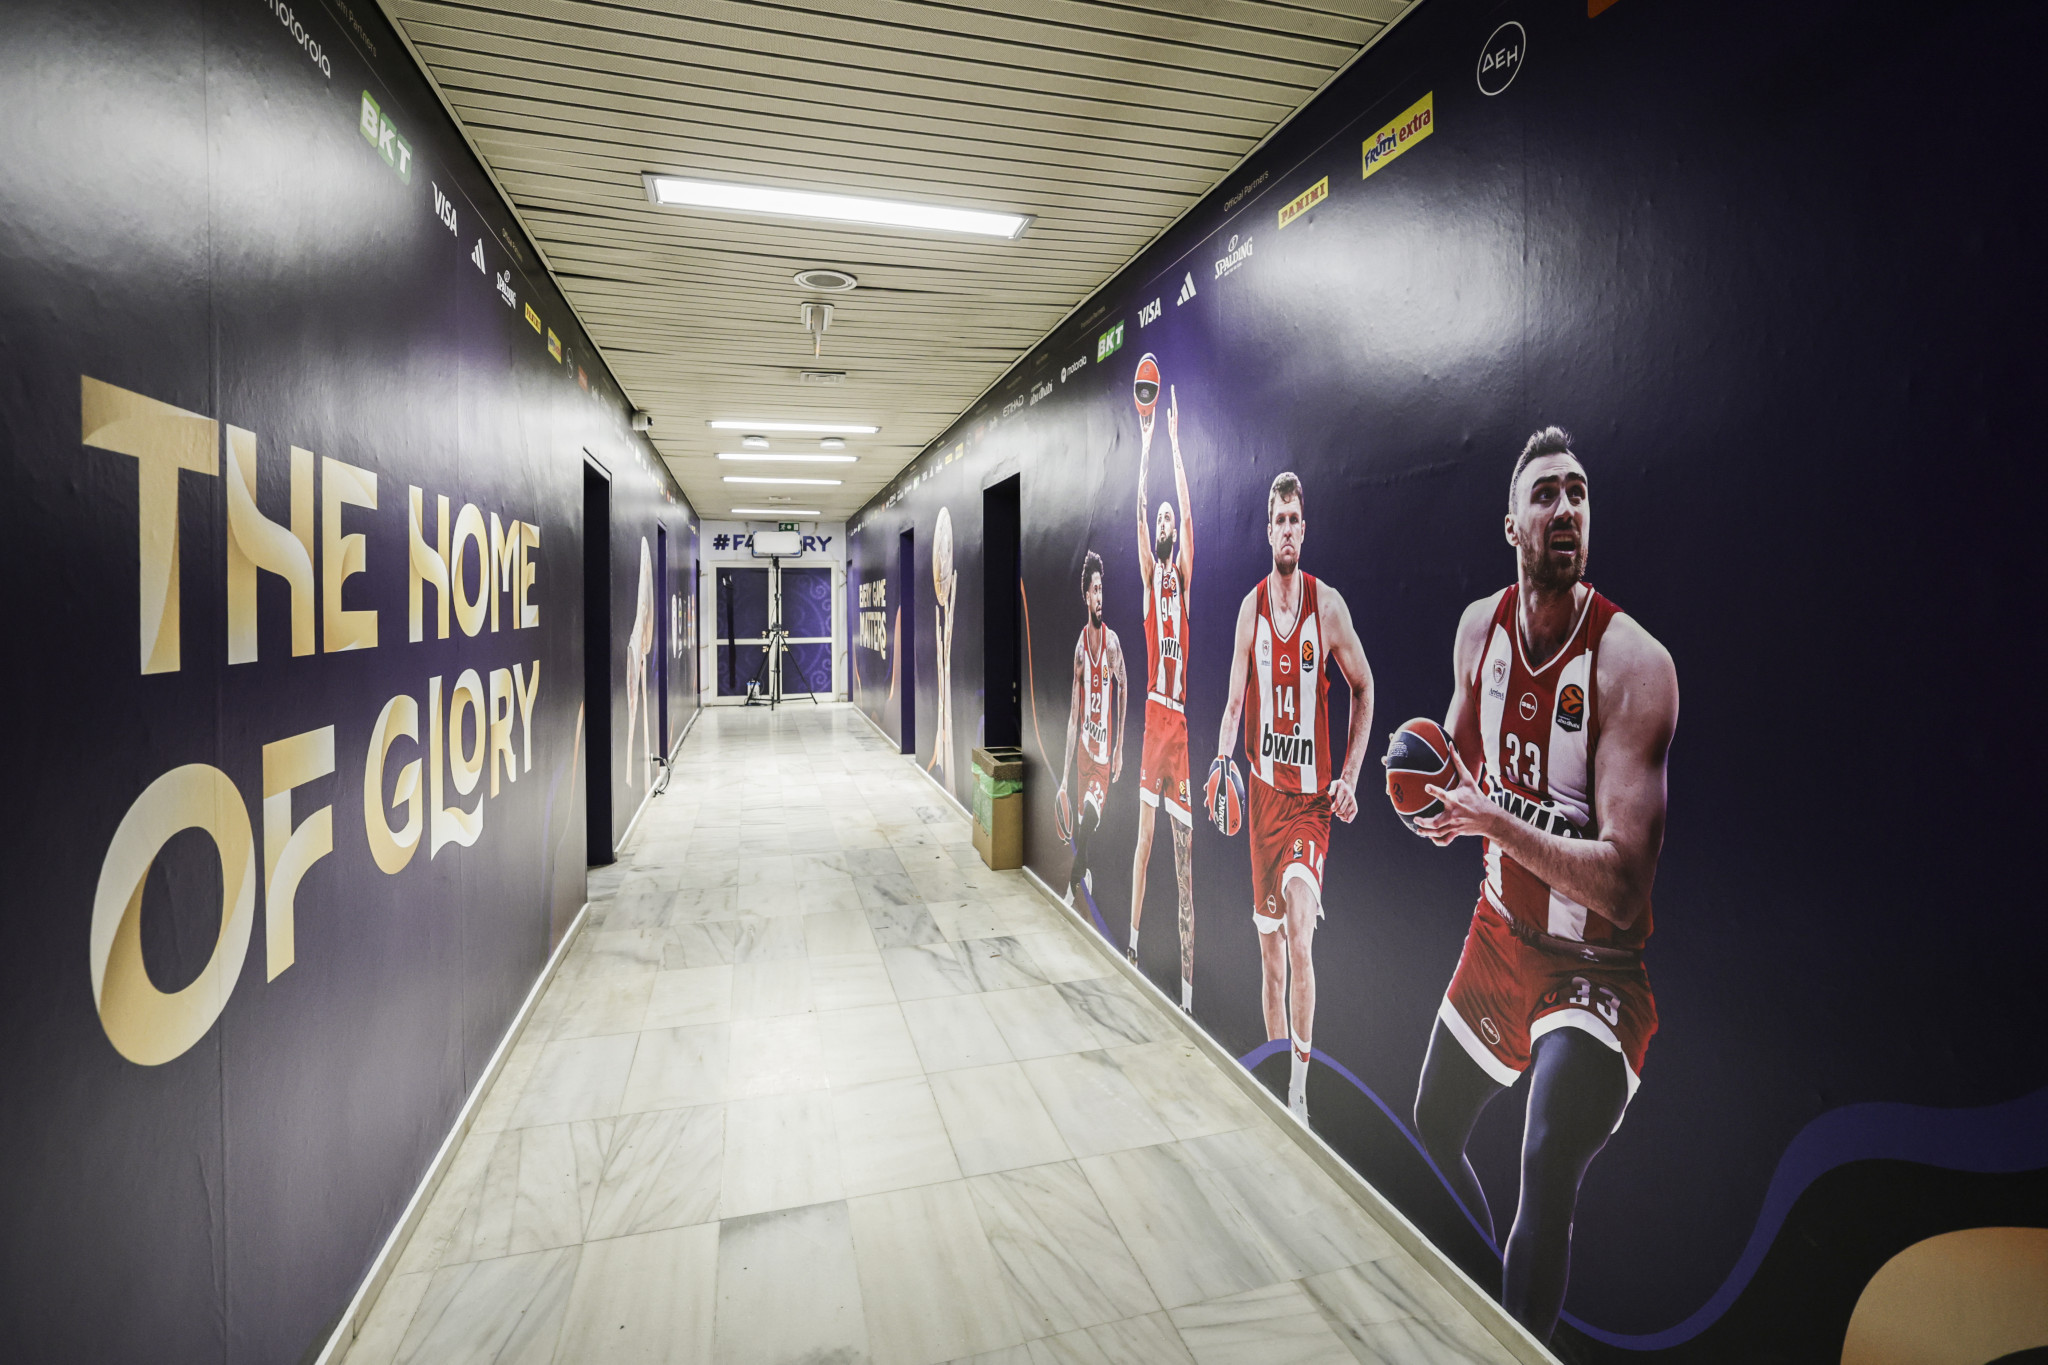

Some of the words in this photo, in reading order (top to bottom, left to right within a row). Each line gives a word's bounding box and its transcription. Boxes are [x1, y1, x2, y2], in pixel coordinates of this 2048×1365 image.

[361, 97, 411, 174] BKT
[1399, 109, 1431, 142] extra
[432, 181, 457, 237] VISA
[1223, 189, 1243, 212] Official
[1244, 170, 1269, 196] Partners
[1281, 182, 1326, 223] PANINI
[1214, 236, 1253, 280] SPALDING
[1137, 297, 1161, 329] VISA
[1098, 324, 1124, 358] BKT
[81, 374, 378, 676] THE
[408, 484, 541, 643] HOME
[1091, 692, 1101, 713] 22
[1275, 685, 1295, 720] 14
[1262, 722, 1313, 766] bwin
[1505, 732, 1540, 792] 33
[89, 725, 335, 1066] OF
[363, 660, 541, 875] GLORY
[1308, 840, 1324, 887] 14
[1569, 976, 1620, 1027] 33
